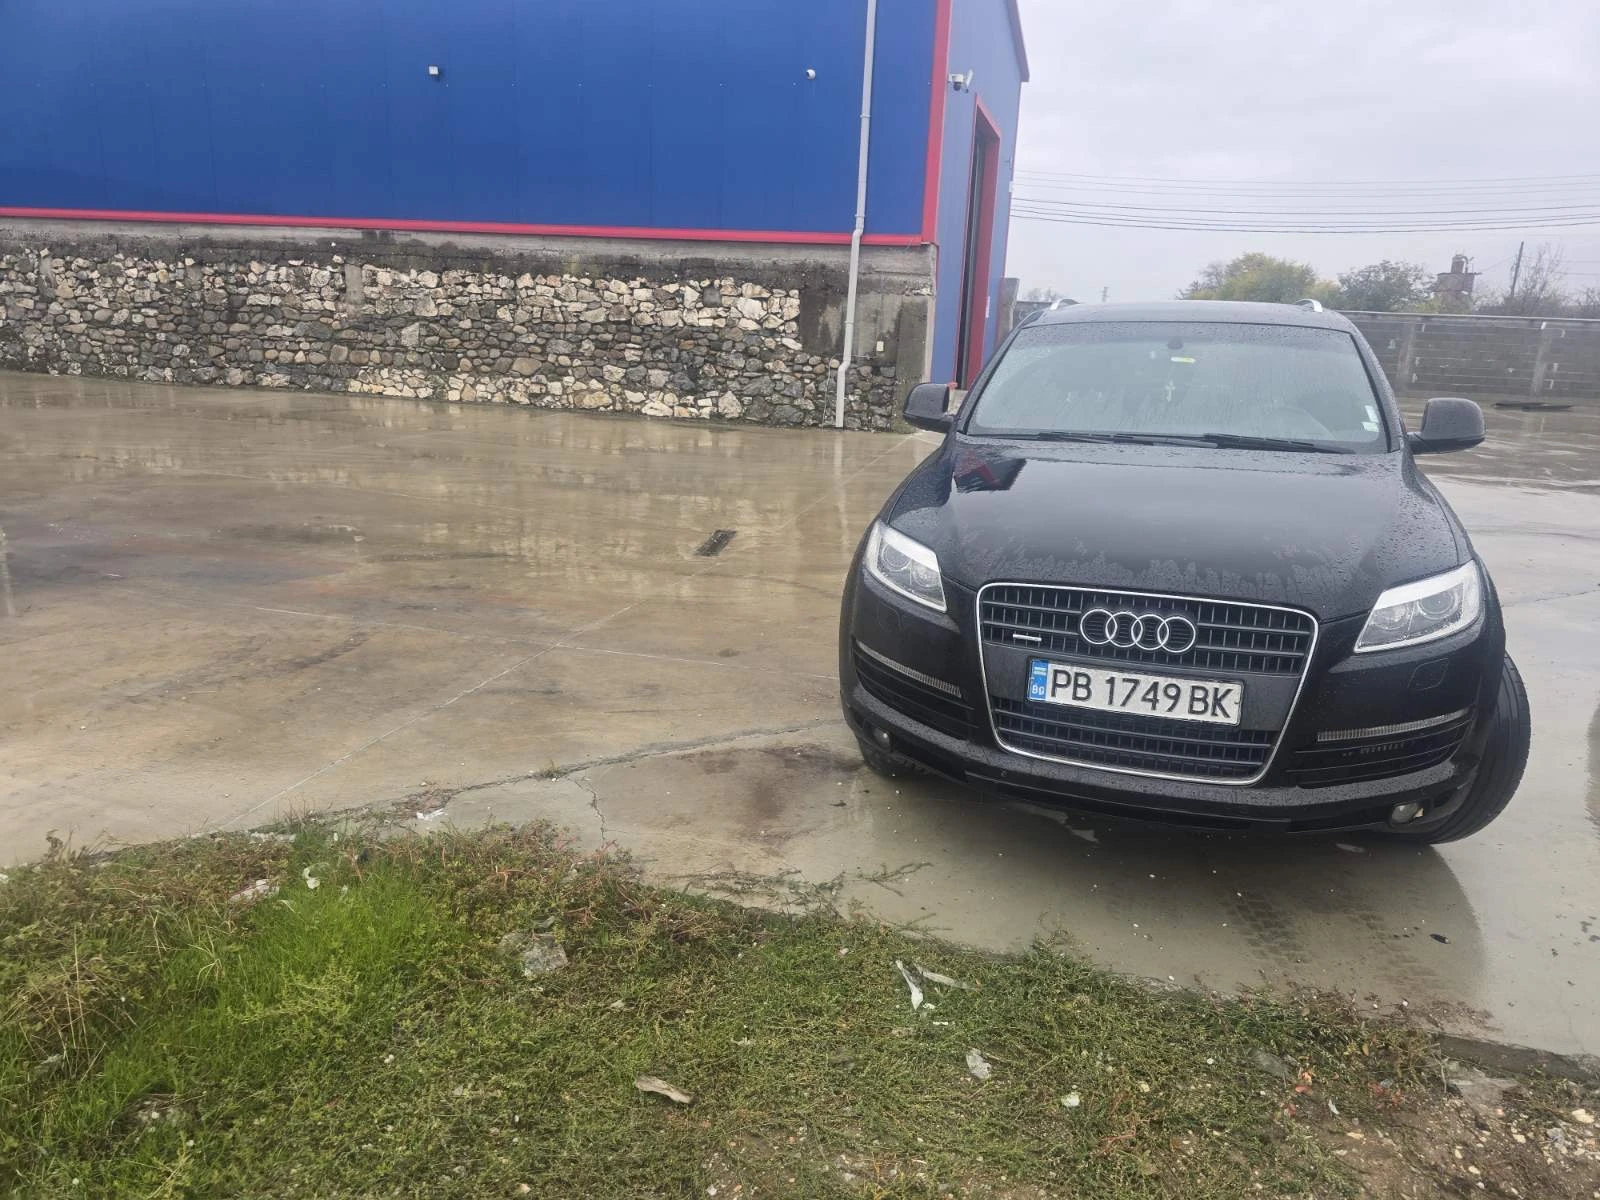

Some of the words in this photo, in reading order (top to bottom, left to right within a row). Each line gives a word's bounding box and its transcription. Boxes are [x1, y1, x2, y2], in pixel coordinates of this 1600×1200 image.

[1050, 669, 1093, 701] PB
[1105, 676, 1182, 713] 1749
[1187, 685, 1234, 719] BK
